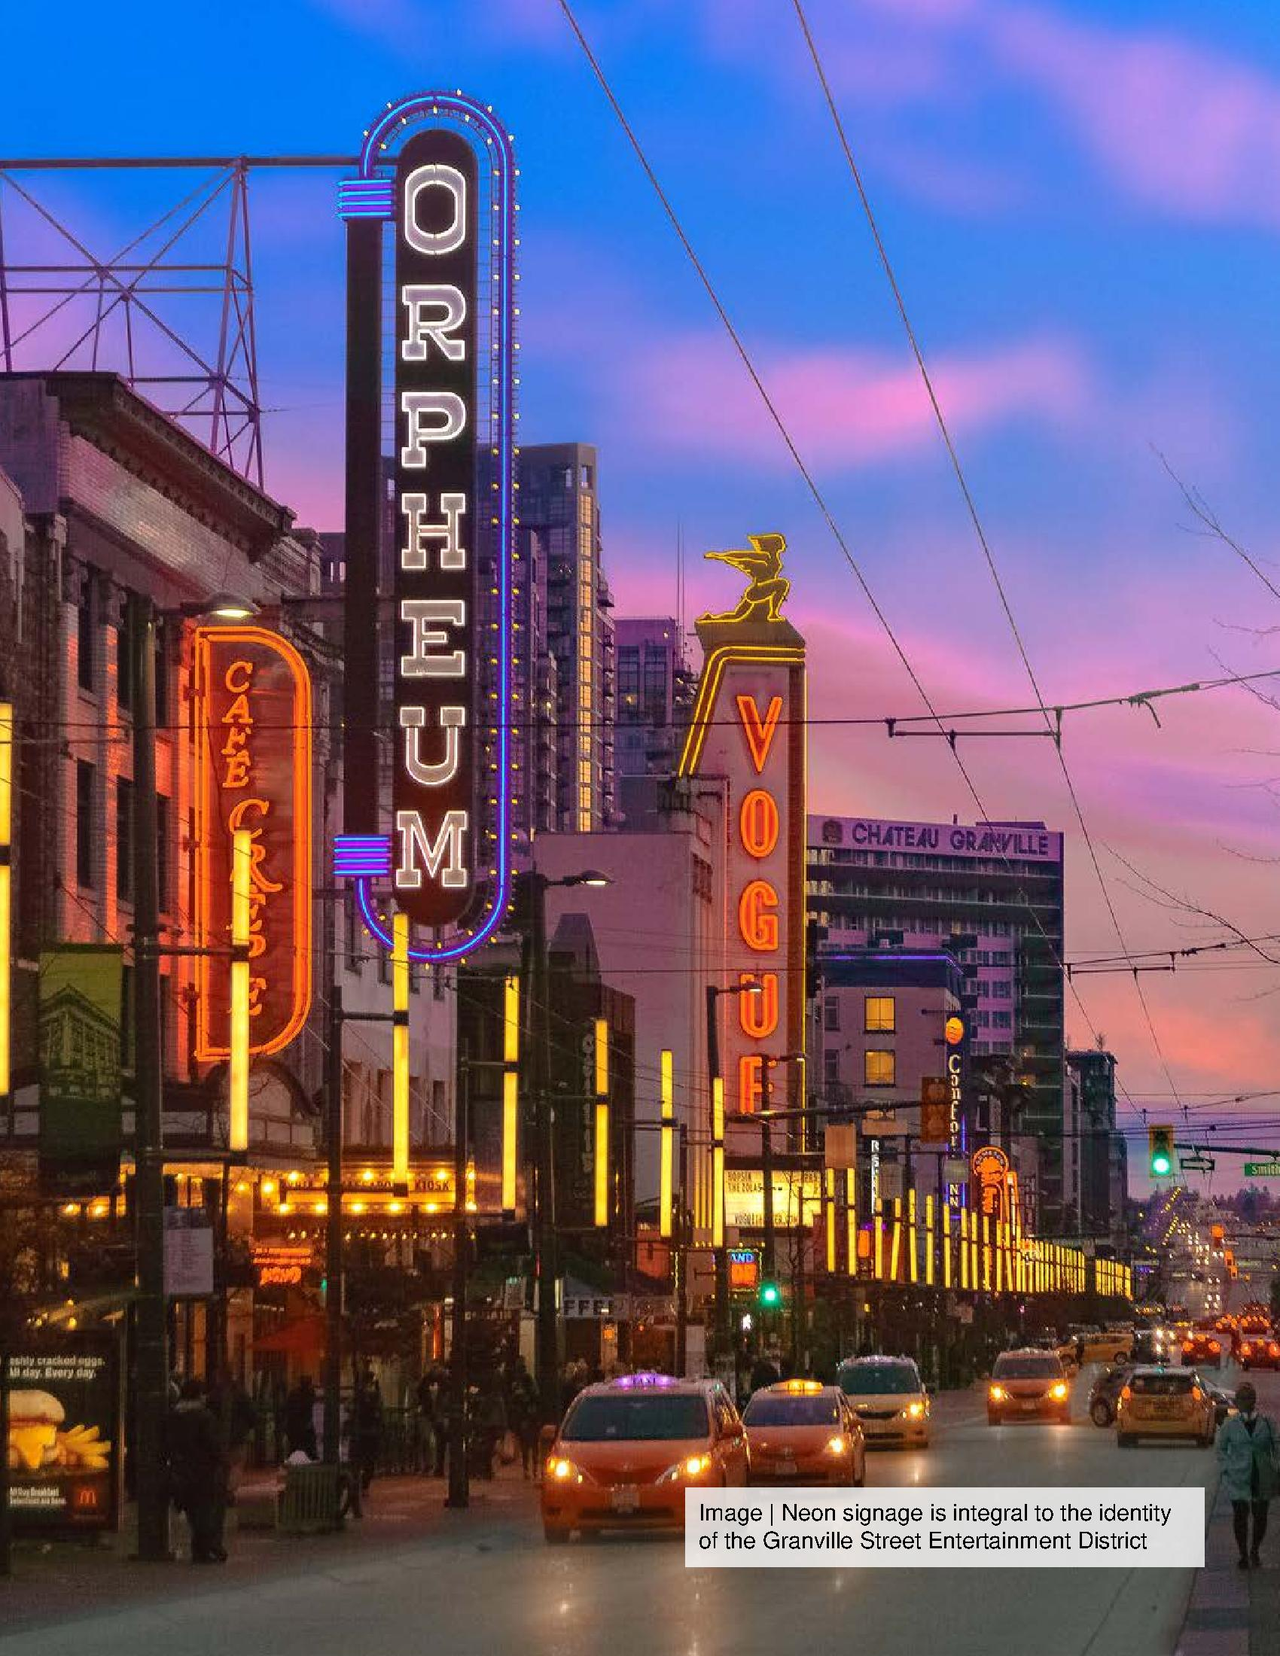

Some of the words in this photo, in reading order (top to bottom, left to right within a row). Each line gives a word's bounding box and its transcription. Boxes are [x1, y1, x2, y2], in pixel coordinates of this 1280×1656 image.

[396, 164, 468, 888] ORPHEUM
[736, 695, 783, 1115] VOGUE
[851, 822, 940, 849] CHATEAU
[950, 829, 1049, 856] GRANVILLE
